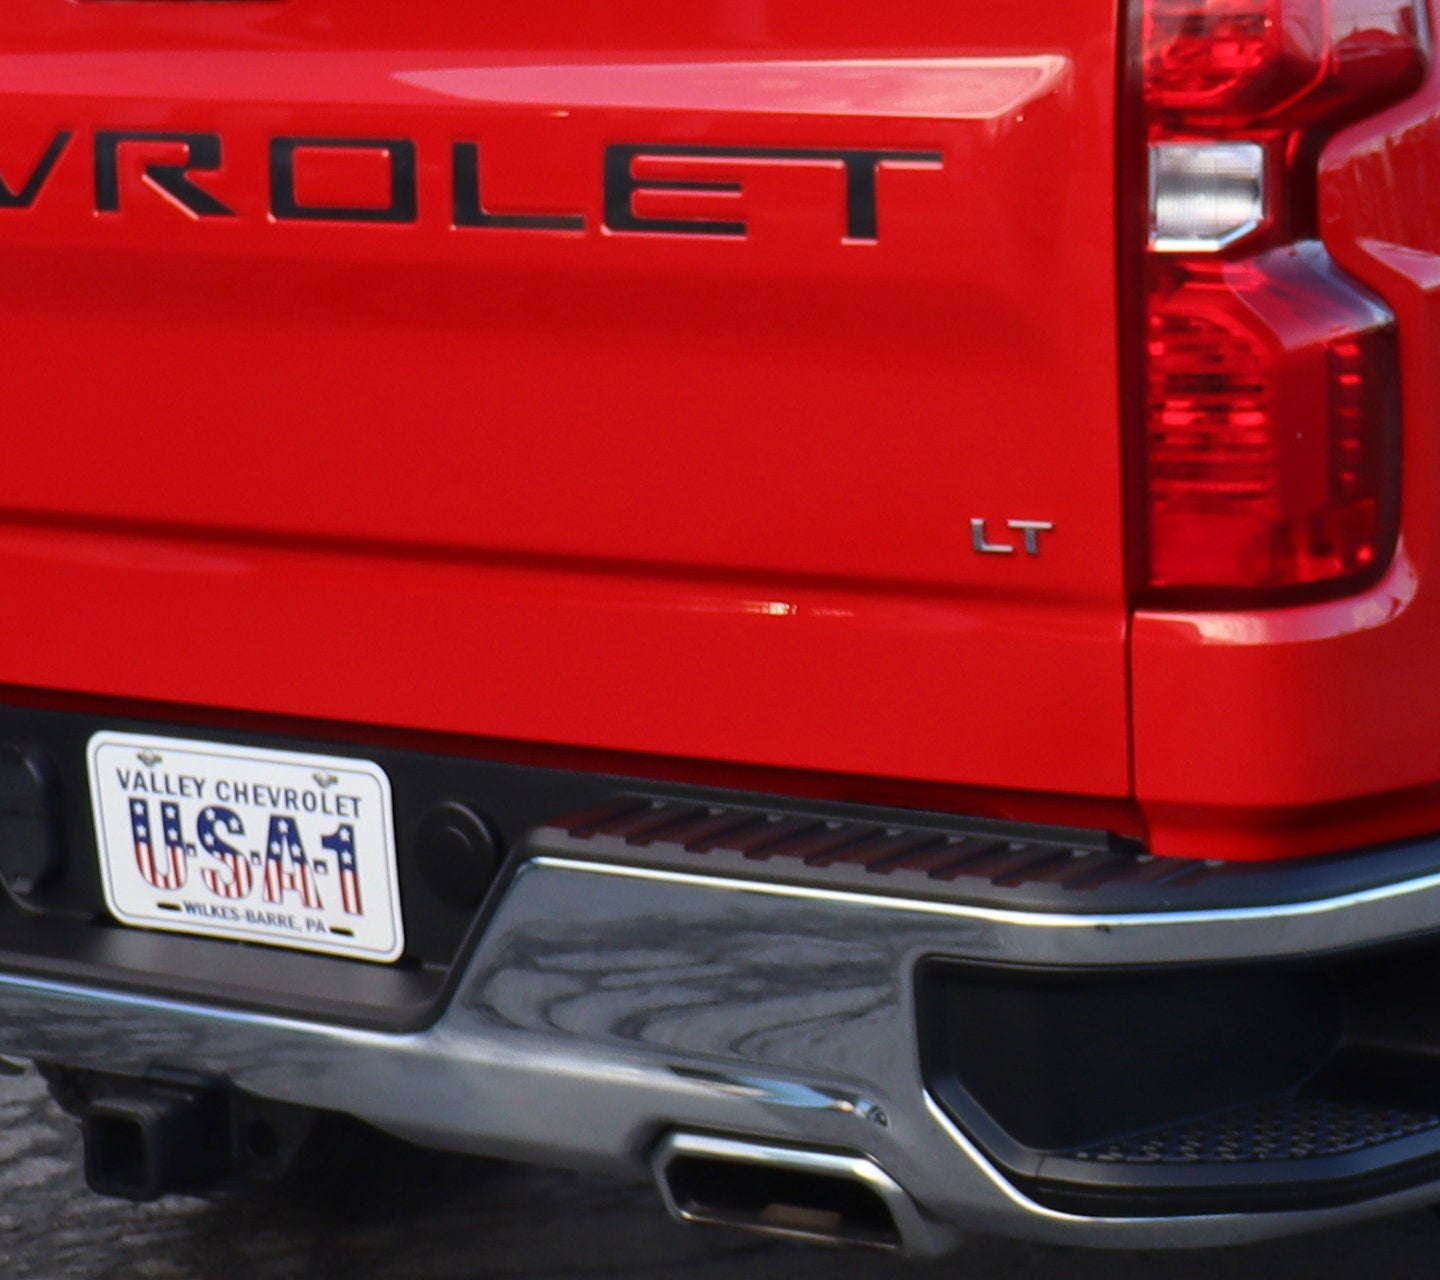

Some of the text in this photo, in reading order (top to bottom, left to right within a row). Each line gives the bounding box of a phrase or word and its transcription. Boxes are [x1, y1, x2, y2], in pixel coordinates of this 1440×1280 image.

[969, 517, 1054, 555] LT
[116, 768, 363, 819] VALLEY CHEVROLET
[182, 900, 328, 934] WILKES-BARRE, PA
